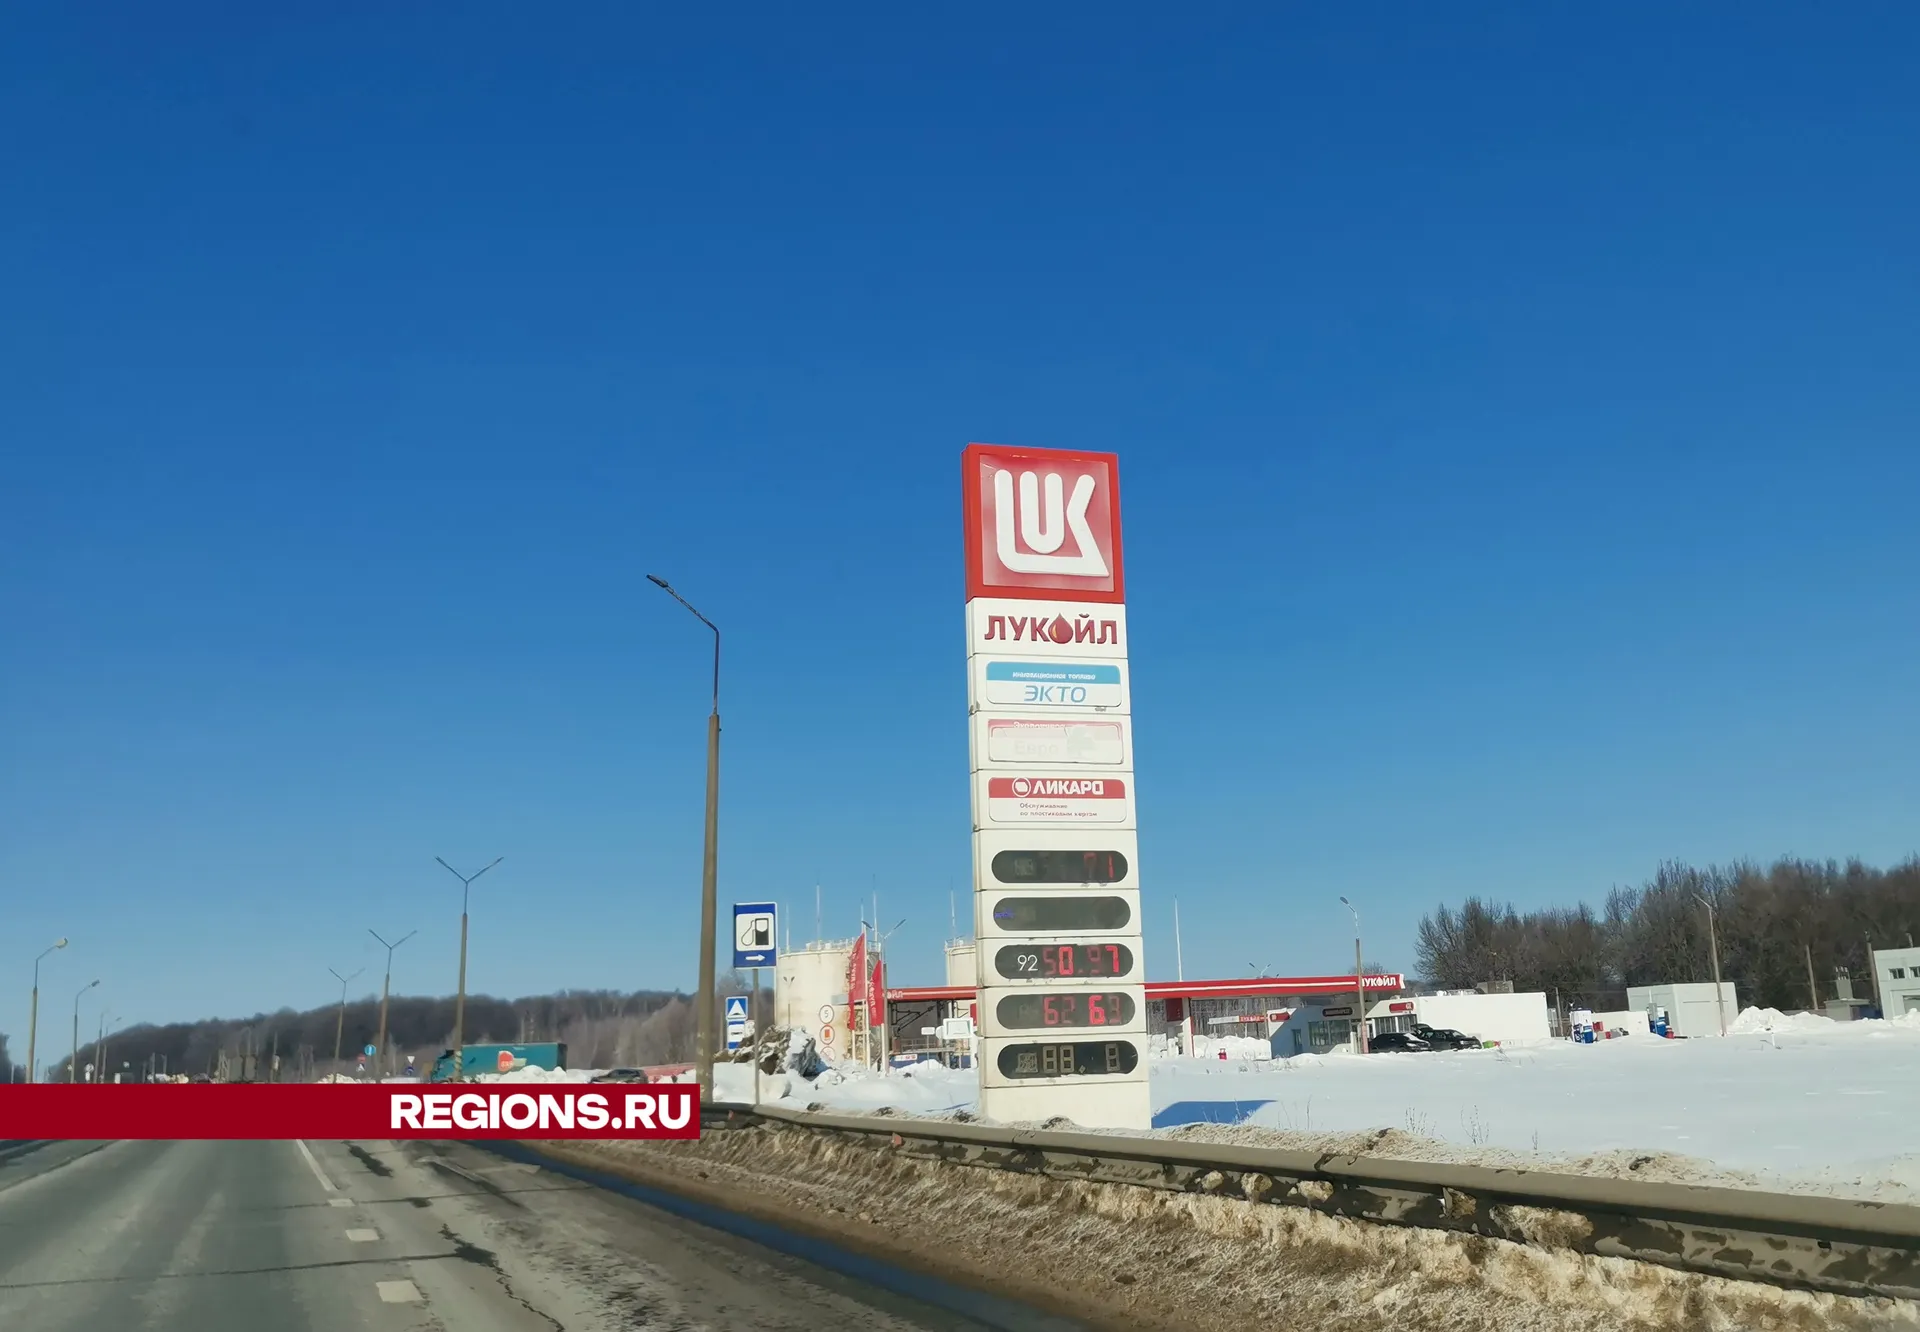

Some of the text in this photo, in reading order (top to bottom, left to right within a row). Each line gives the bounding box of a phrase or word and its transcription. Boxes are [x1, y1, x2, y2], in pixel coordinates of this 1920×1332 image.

[984, 612, 1118, 645] ЛУКОЙЛ
[1024, 685, 1087, 703] ЭКТО
[1017, 954, 1039, 972] 92
